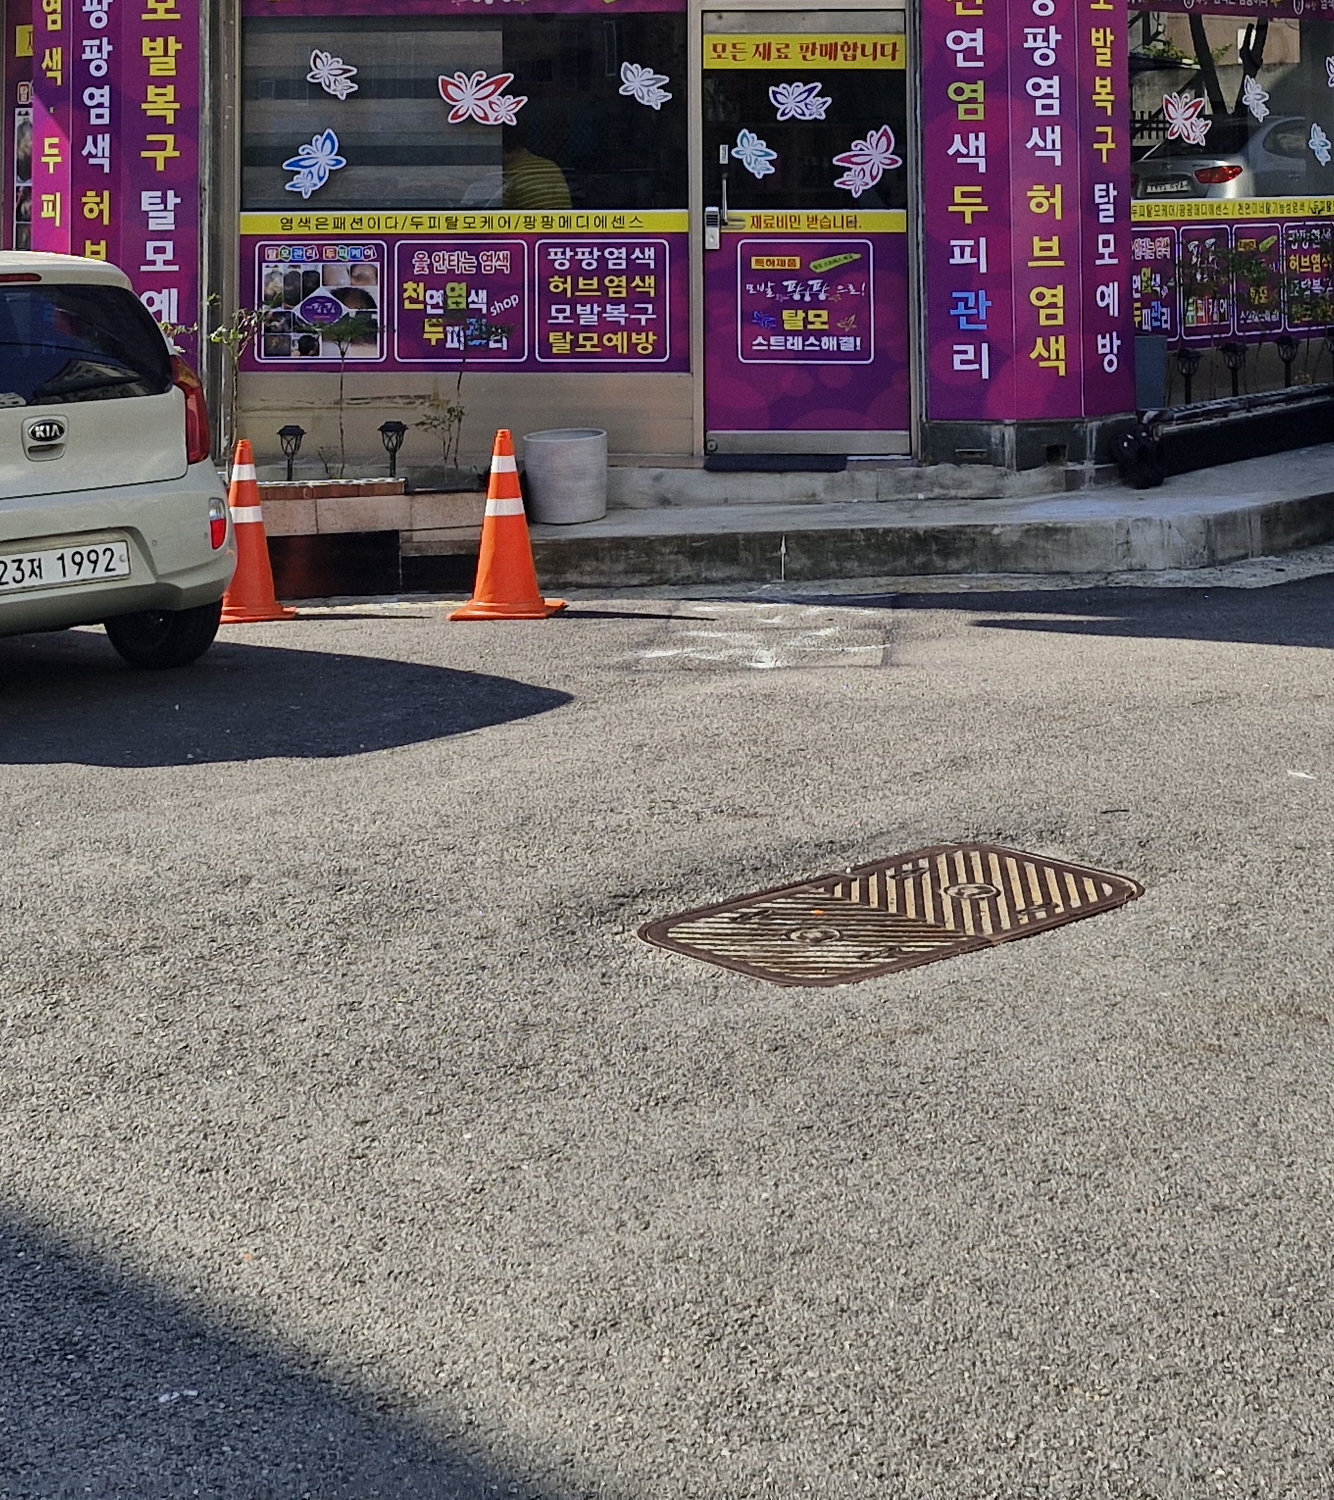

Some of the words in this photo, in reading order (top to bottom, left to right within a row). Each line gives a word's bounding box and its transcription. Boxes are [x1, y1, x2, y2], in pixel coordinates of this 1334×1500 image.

[710, 42, 748, 62] 모든
[752, 41, 792, 62] 재료
[798, 40, 900, 62] 판매합니다
[750, 214, 801, 230] 재료비만
[432, 251, 477, 274] 안타는
[479, 251, 510, 274] 염색
[547, 247, 655, 270] 팡팡염색
[548, 275, 655, 298] 허브염색
[403, 281, 487, 314] 천연염색
[490, 294, 519, 316] shop
[547, 303, 657, 326] 모발복구
[782, 309, 829, 330] 탈모
[548, 330, 657, 355] 탈모예방
[752, 335, 861, 351] 스트레스해결!
[32, 421, 62, 441] KIA
[56, 547, 117, 578] 1992
